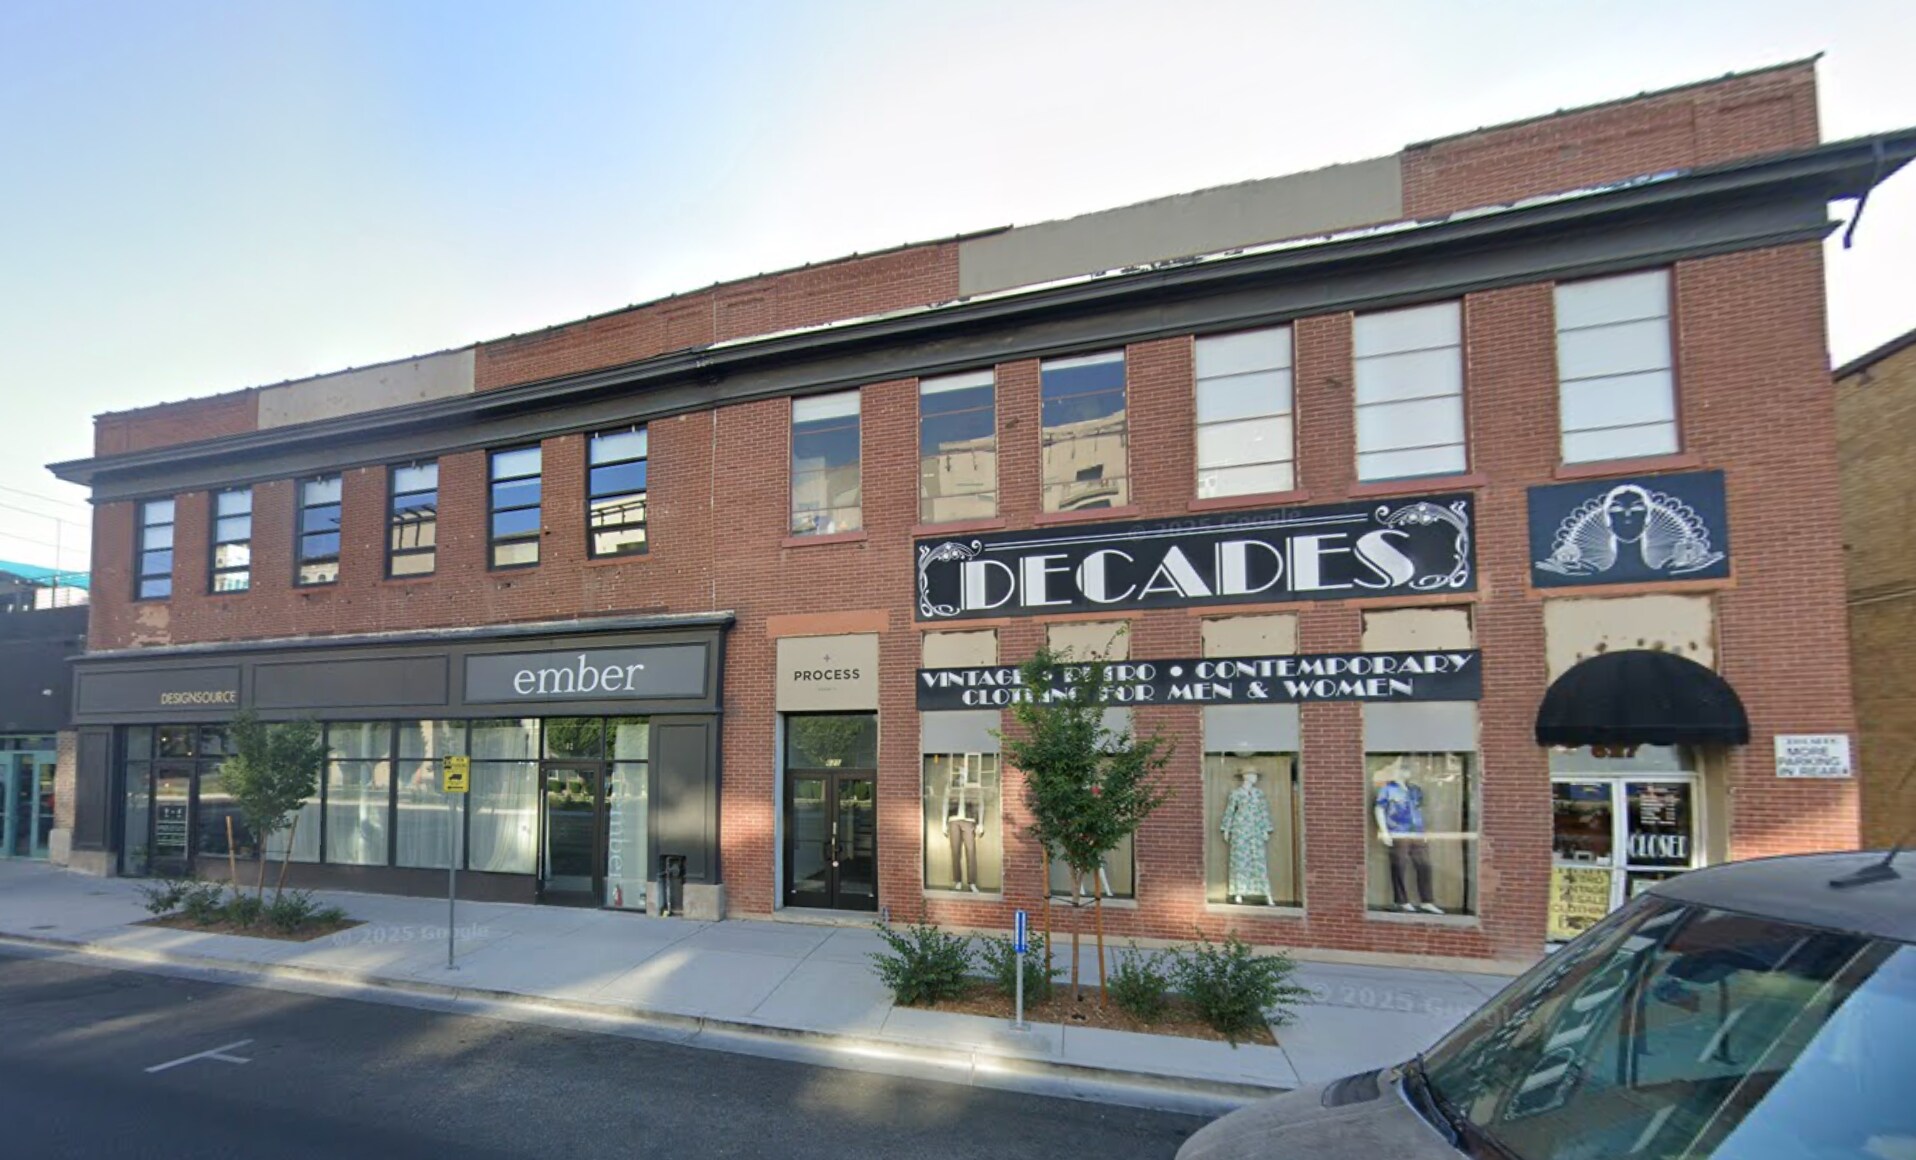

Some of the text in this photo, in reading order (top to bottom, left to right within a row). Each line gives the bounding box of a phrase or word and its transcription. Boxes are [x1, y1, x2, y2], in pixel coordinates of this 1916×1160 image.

[960, 528, 1415, 612] DECADES
[513, 654, 645, 695] ember
[794, 668, 861, 682] PROCESS
[1195, 653, 1473, 680] CONTEMPORARY
[160, 690, 237, 705] DESIGNSOURCE
[1167, 682, 1233, 700] MEN
[1247, 680, 1268, 699] &
[1282, 676, 1414, 699] WOMEN
